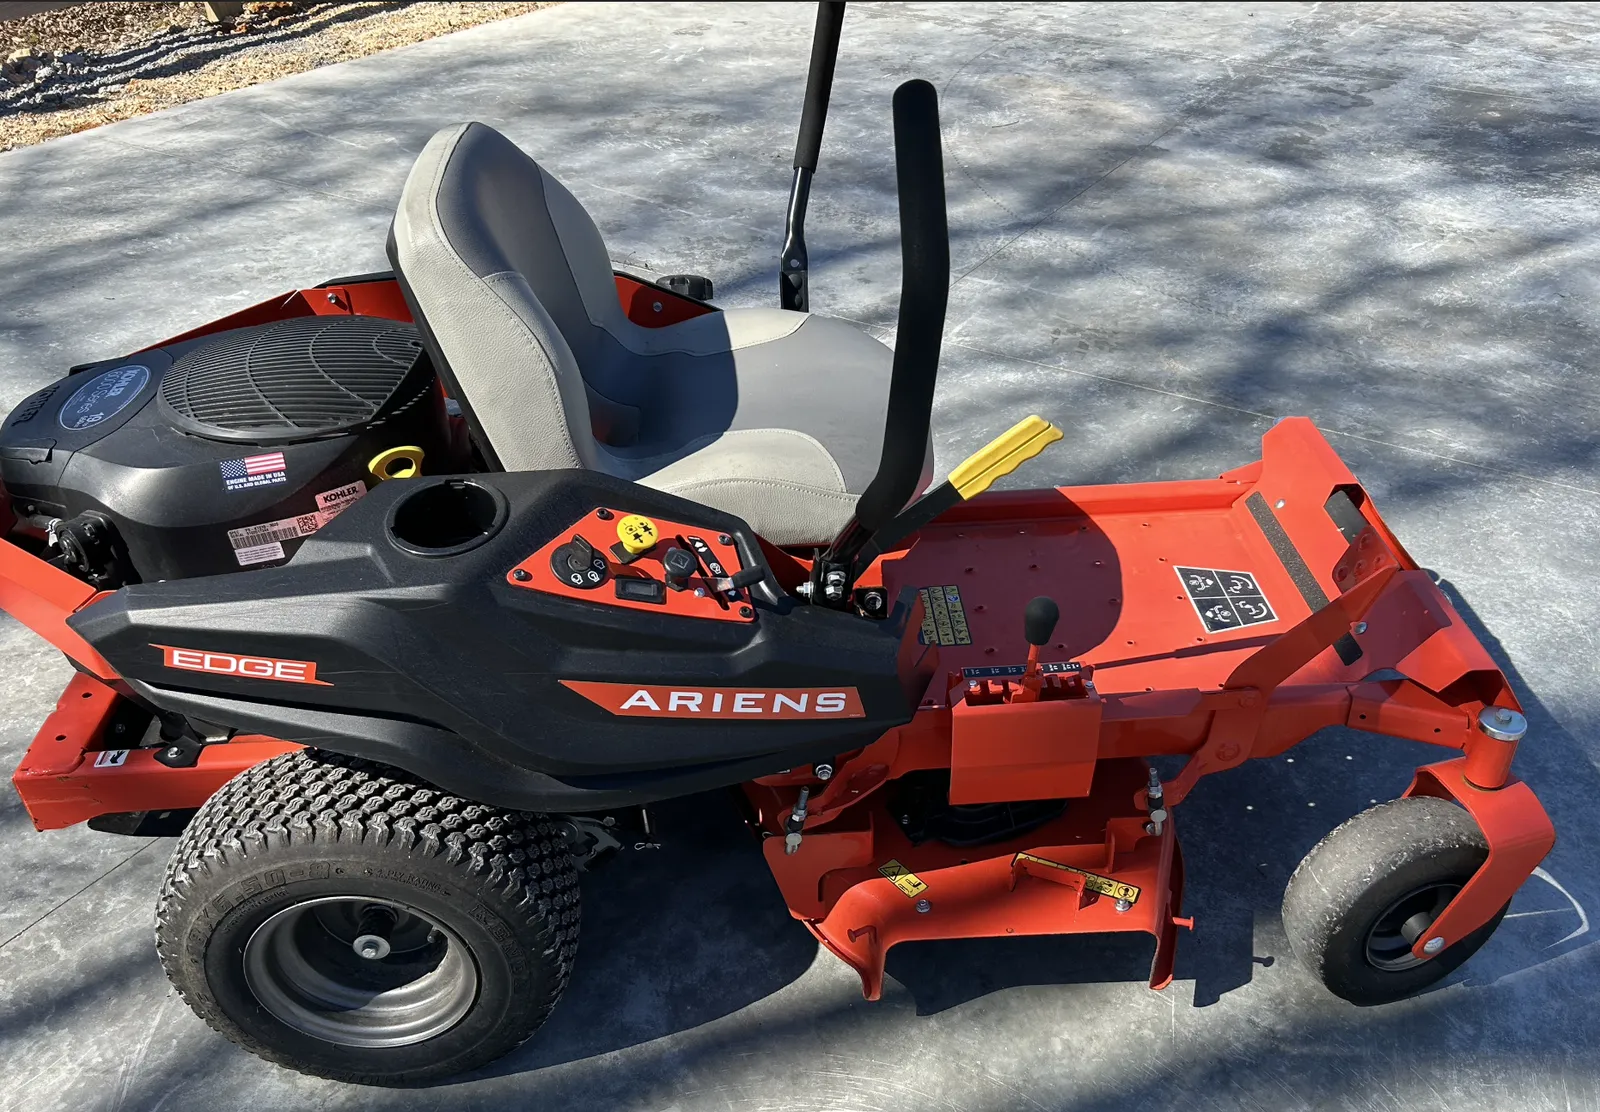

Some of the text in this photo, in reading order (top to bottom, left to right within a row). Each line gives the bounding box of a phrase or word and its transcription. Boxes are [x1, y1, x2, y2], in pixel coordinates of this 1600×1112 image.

[226, 477, 248, 486] ENGINE
[248, 474, 265, 482] MADE
[323, 486, 358, 503] KOHLER
[172, 649, 307, 680] EDGE
[619, 689, 847, 713] ARIENS
